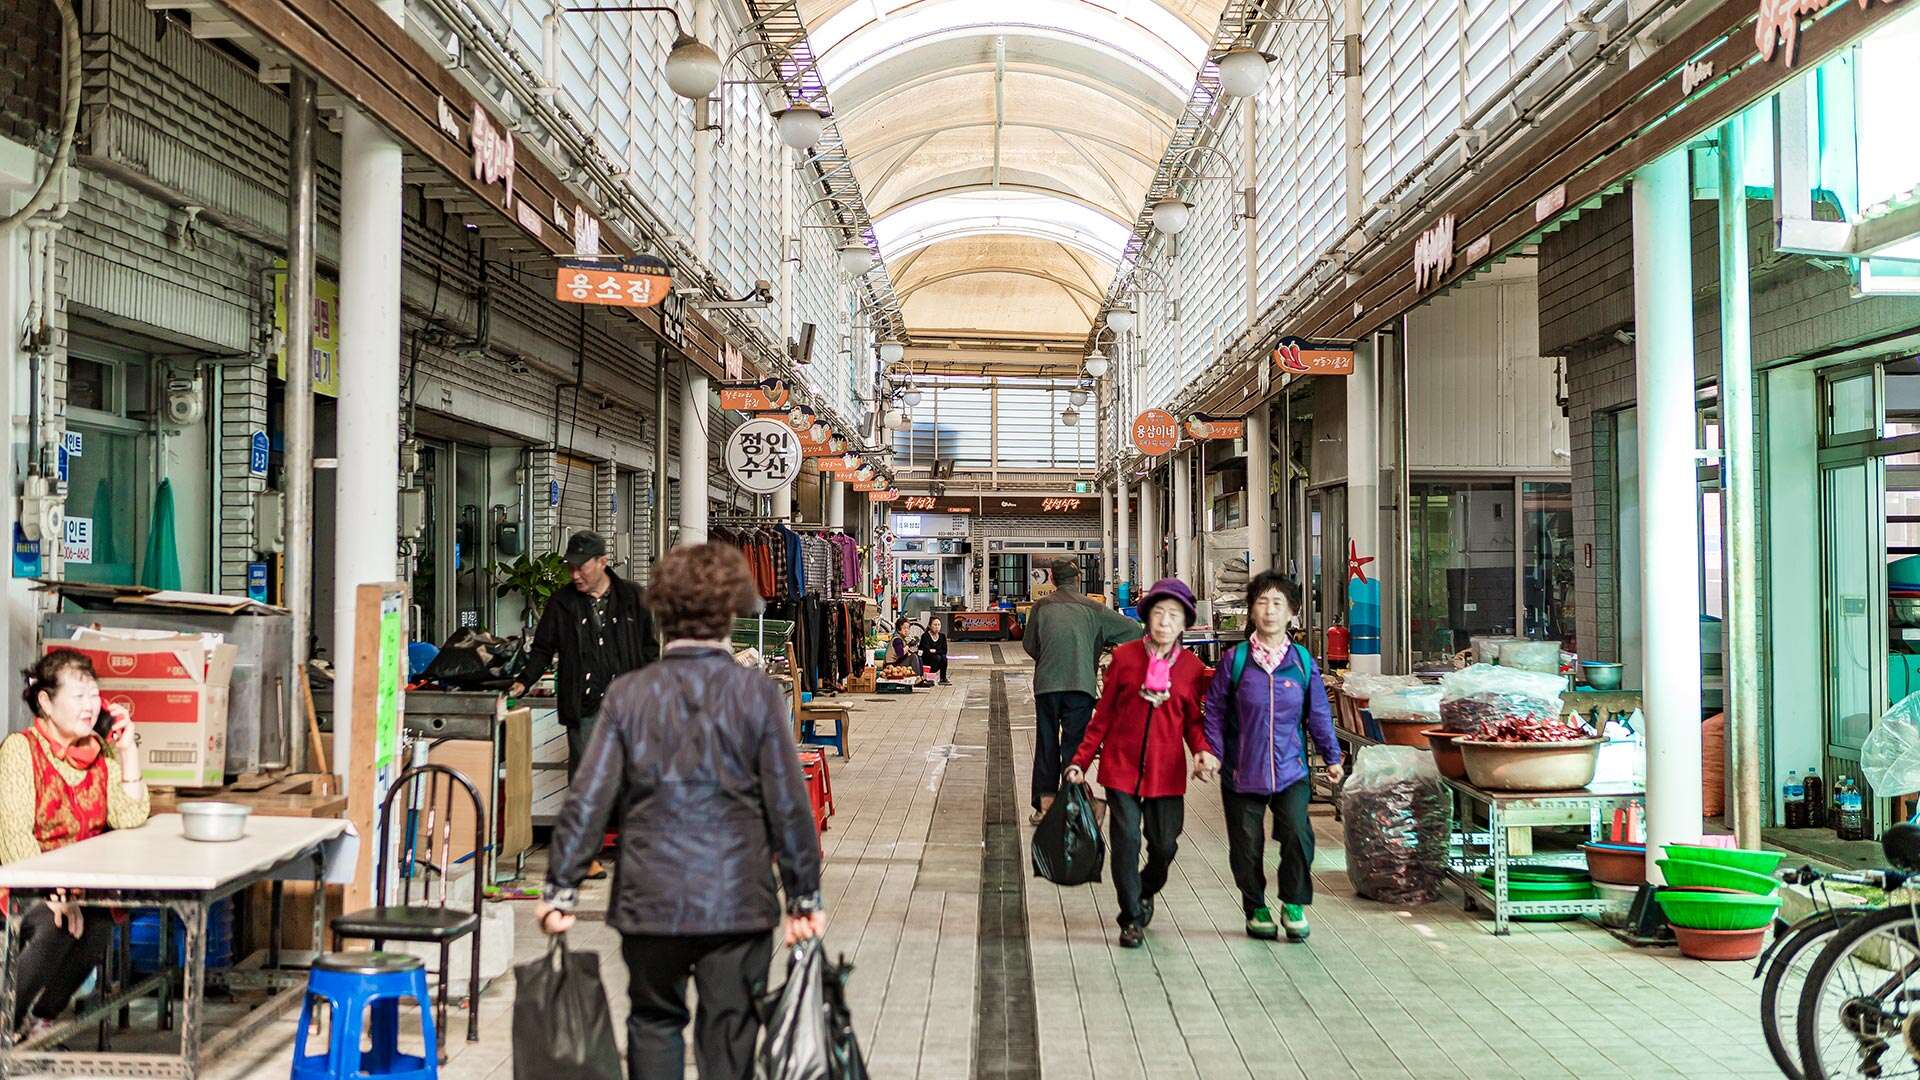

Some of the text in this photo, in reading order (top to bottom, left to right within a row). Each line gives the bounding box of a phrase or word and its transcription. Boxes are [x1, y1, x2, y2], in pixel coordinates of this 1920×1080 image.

[566, 273, 650, 303] 용소집
[738, 432, 788, 454] 정인
[738, 457, 789, 479] 수산
